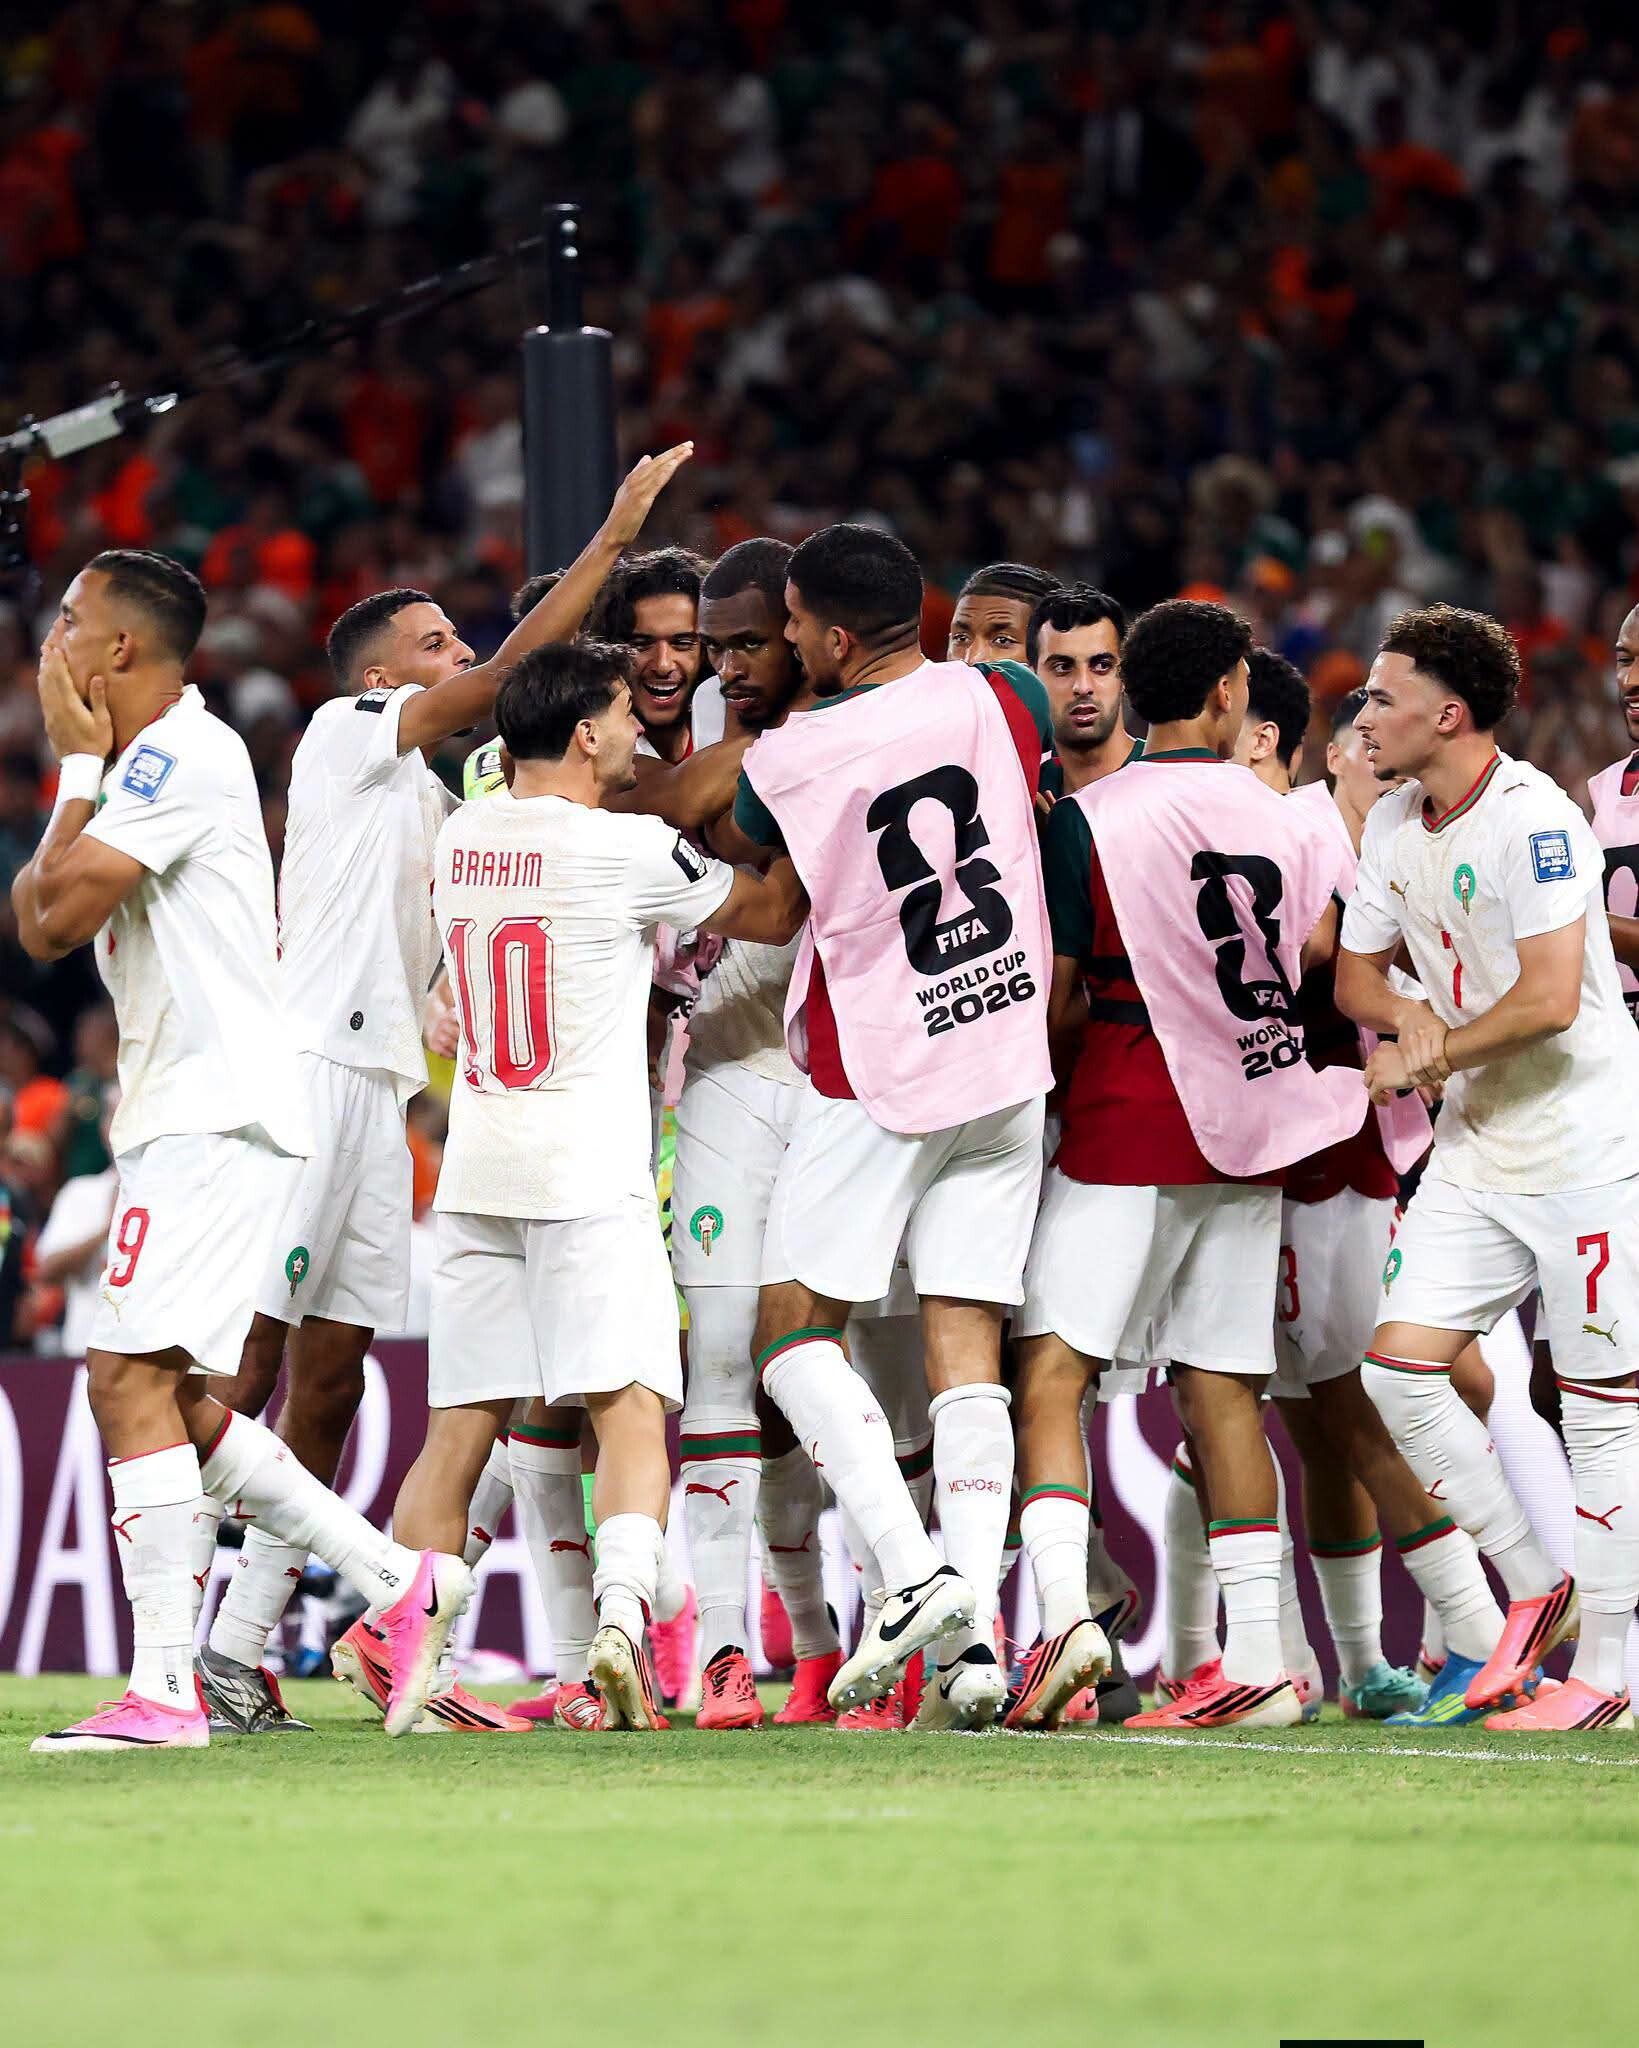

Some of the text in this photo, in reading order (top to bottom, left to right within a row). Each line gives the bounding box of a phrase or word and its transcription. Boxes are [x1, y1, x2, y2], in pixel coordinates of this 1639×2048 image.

[451, 848, 542, 887] BRAHIM
[935, 917, 990, 955] FIFA
[446, 915, 558, 1094] 10
[915, 950, 1027, 1008] WORLD CUP
[923, 971, 1036, 1038] 2026
[109, 1207, 151, 1288] 9
[1576, 1231, 1610, 1314] 7
